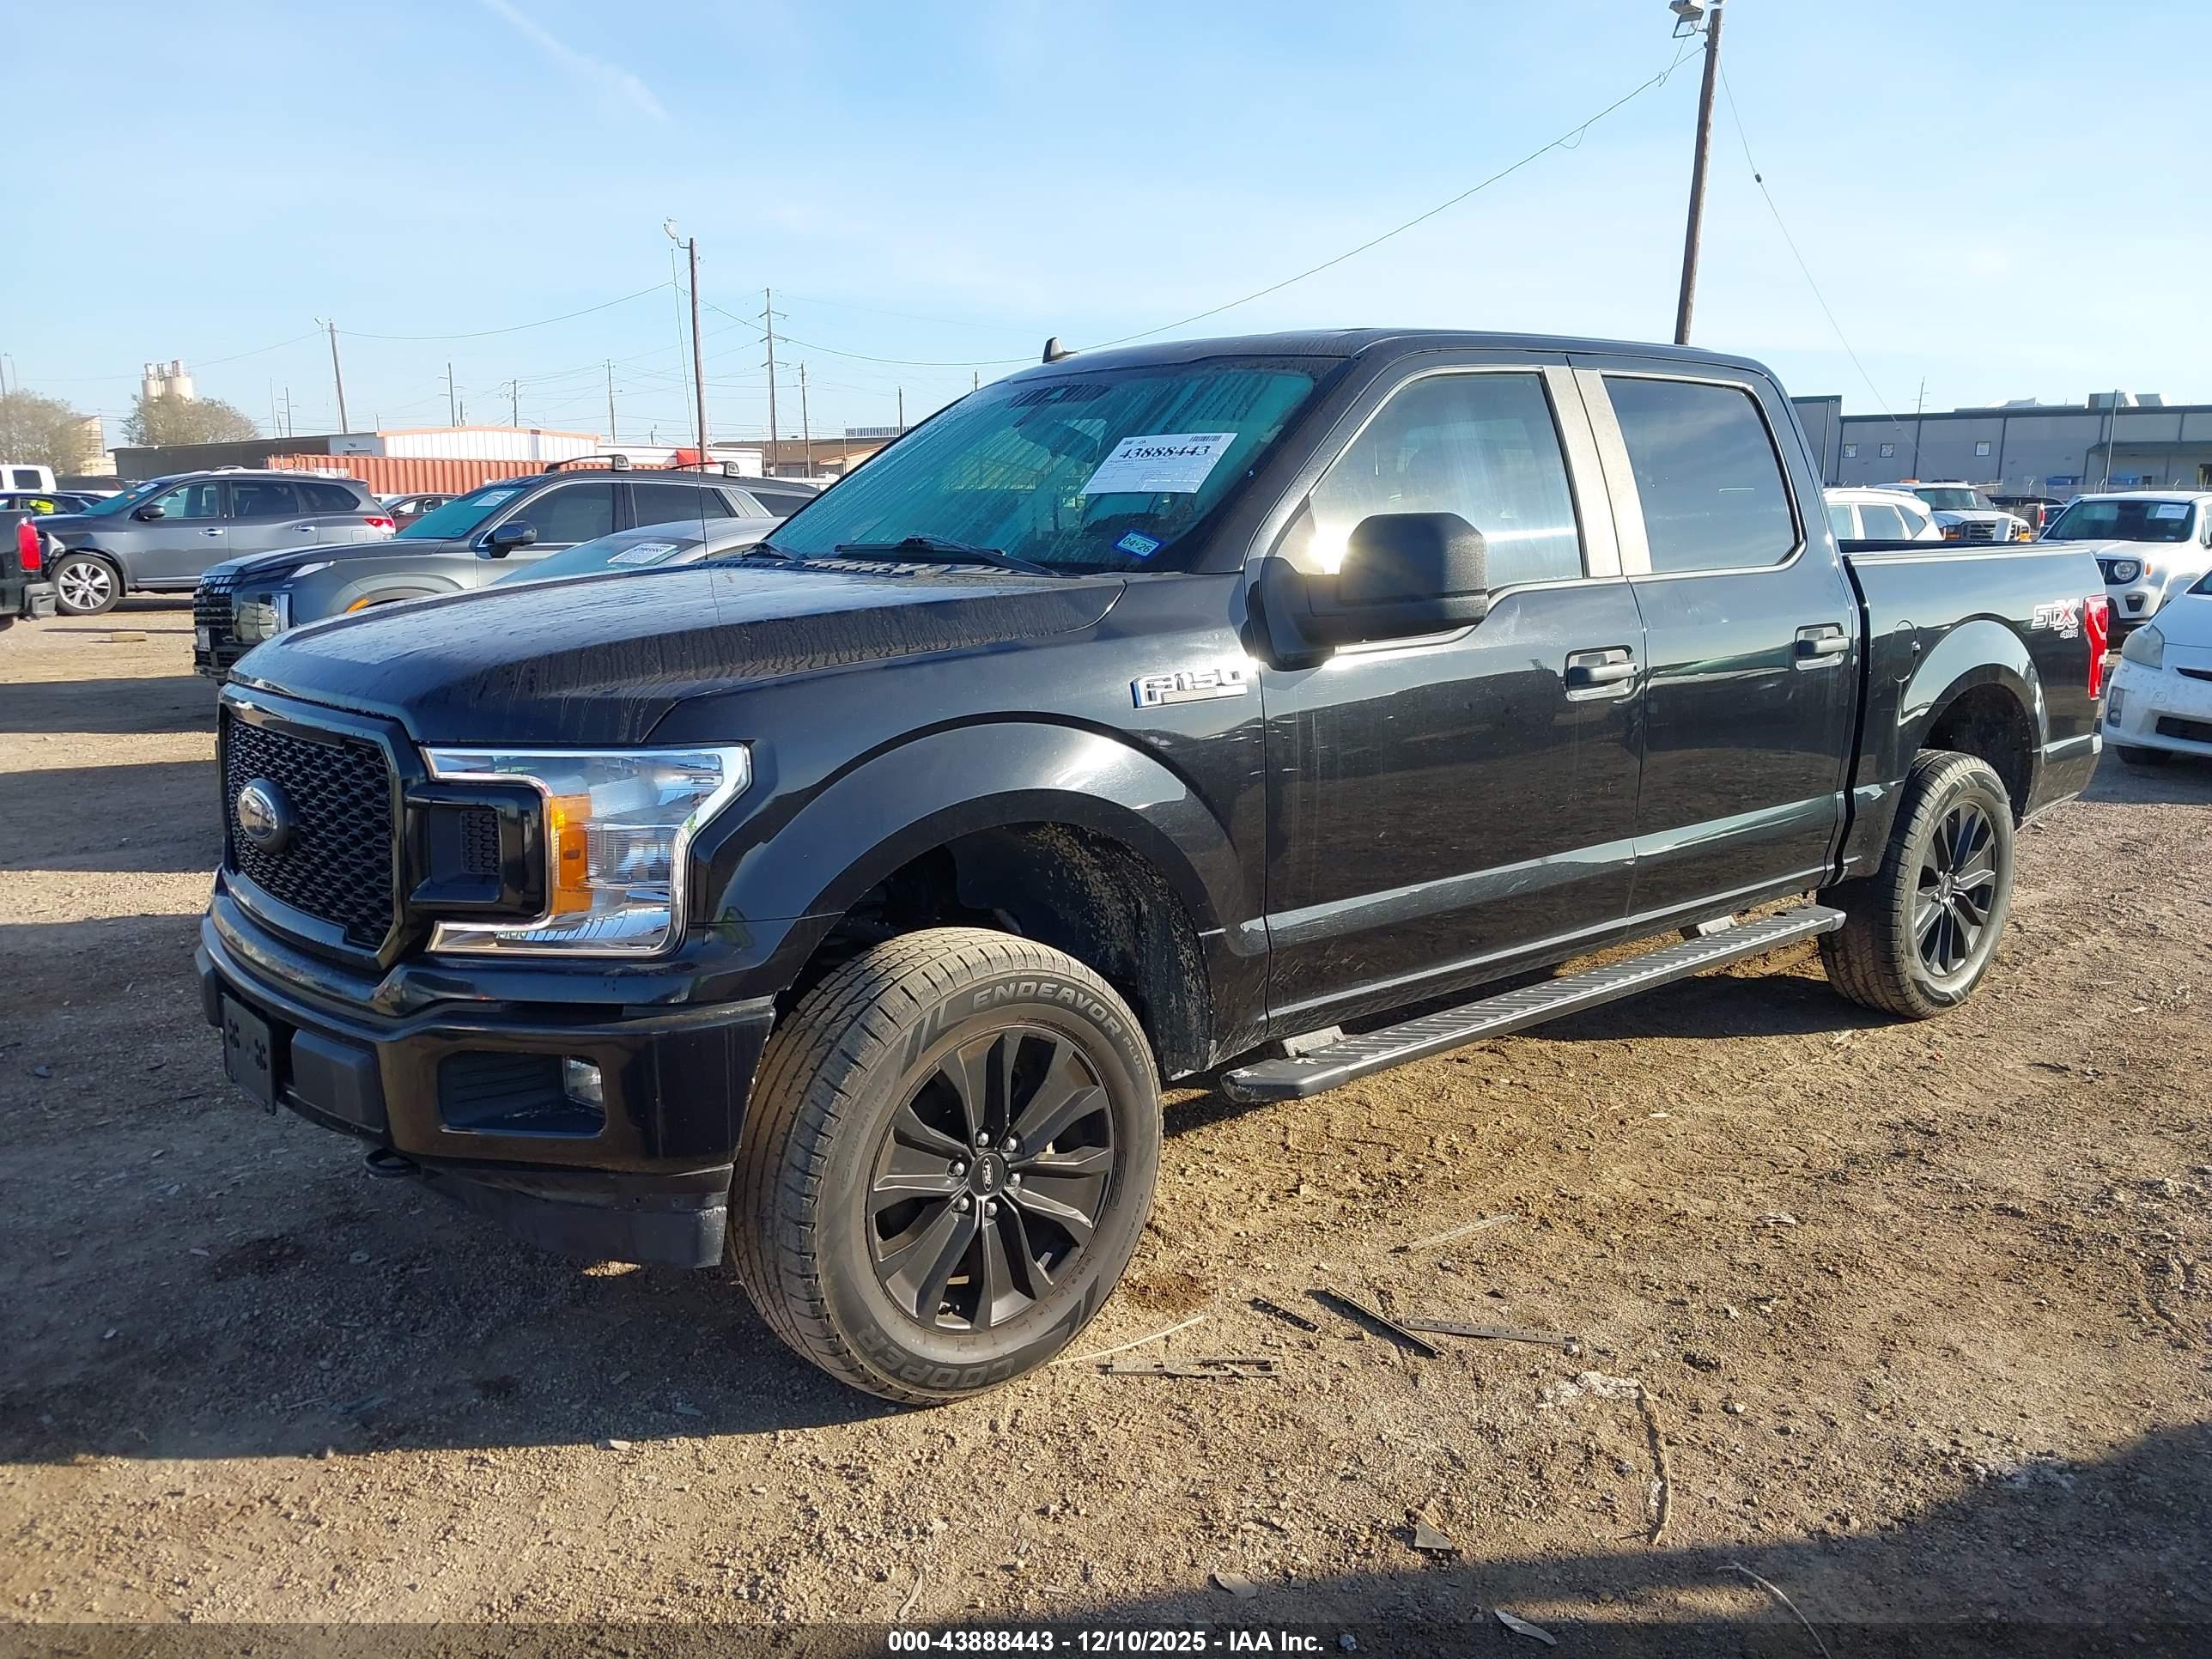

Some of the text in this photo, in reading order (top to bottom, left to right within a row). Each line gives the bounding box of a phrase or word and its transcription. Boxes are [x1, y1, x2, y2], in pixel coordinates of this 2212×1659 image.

[1119, 445, 1211, 459] 43888443
[2031, 599, 2079, 631] STX
[972, 981, 1122, 1038] ENDEAVOR
[1122, 1036, 1146, 1076] PLUS
[856, 1323, 1015, 1389] COOPER
